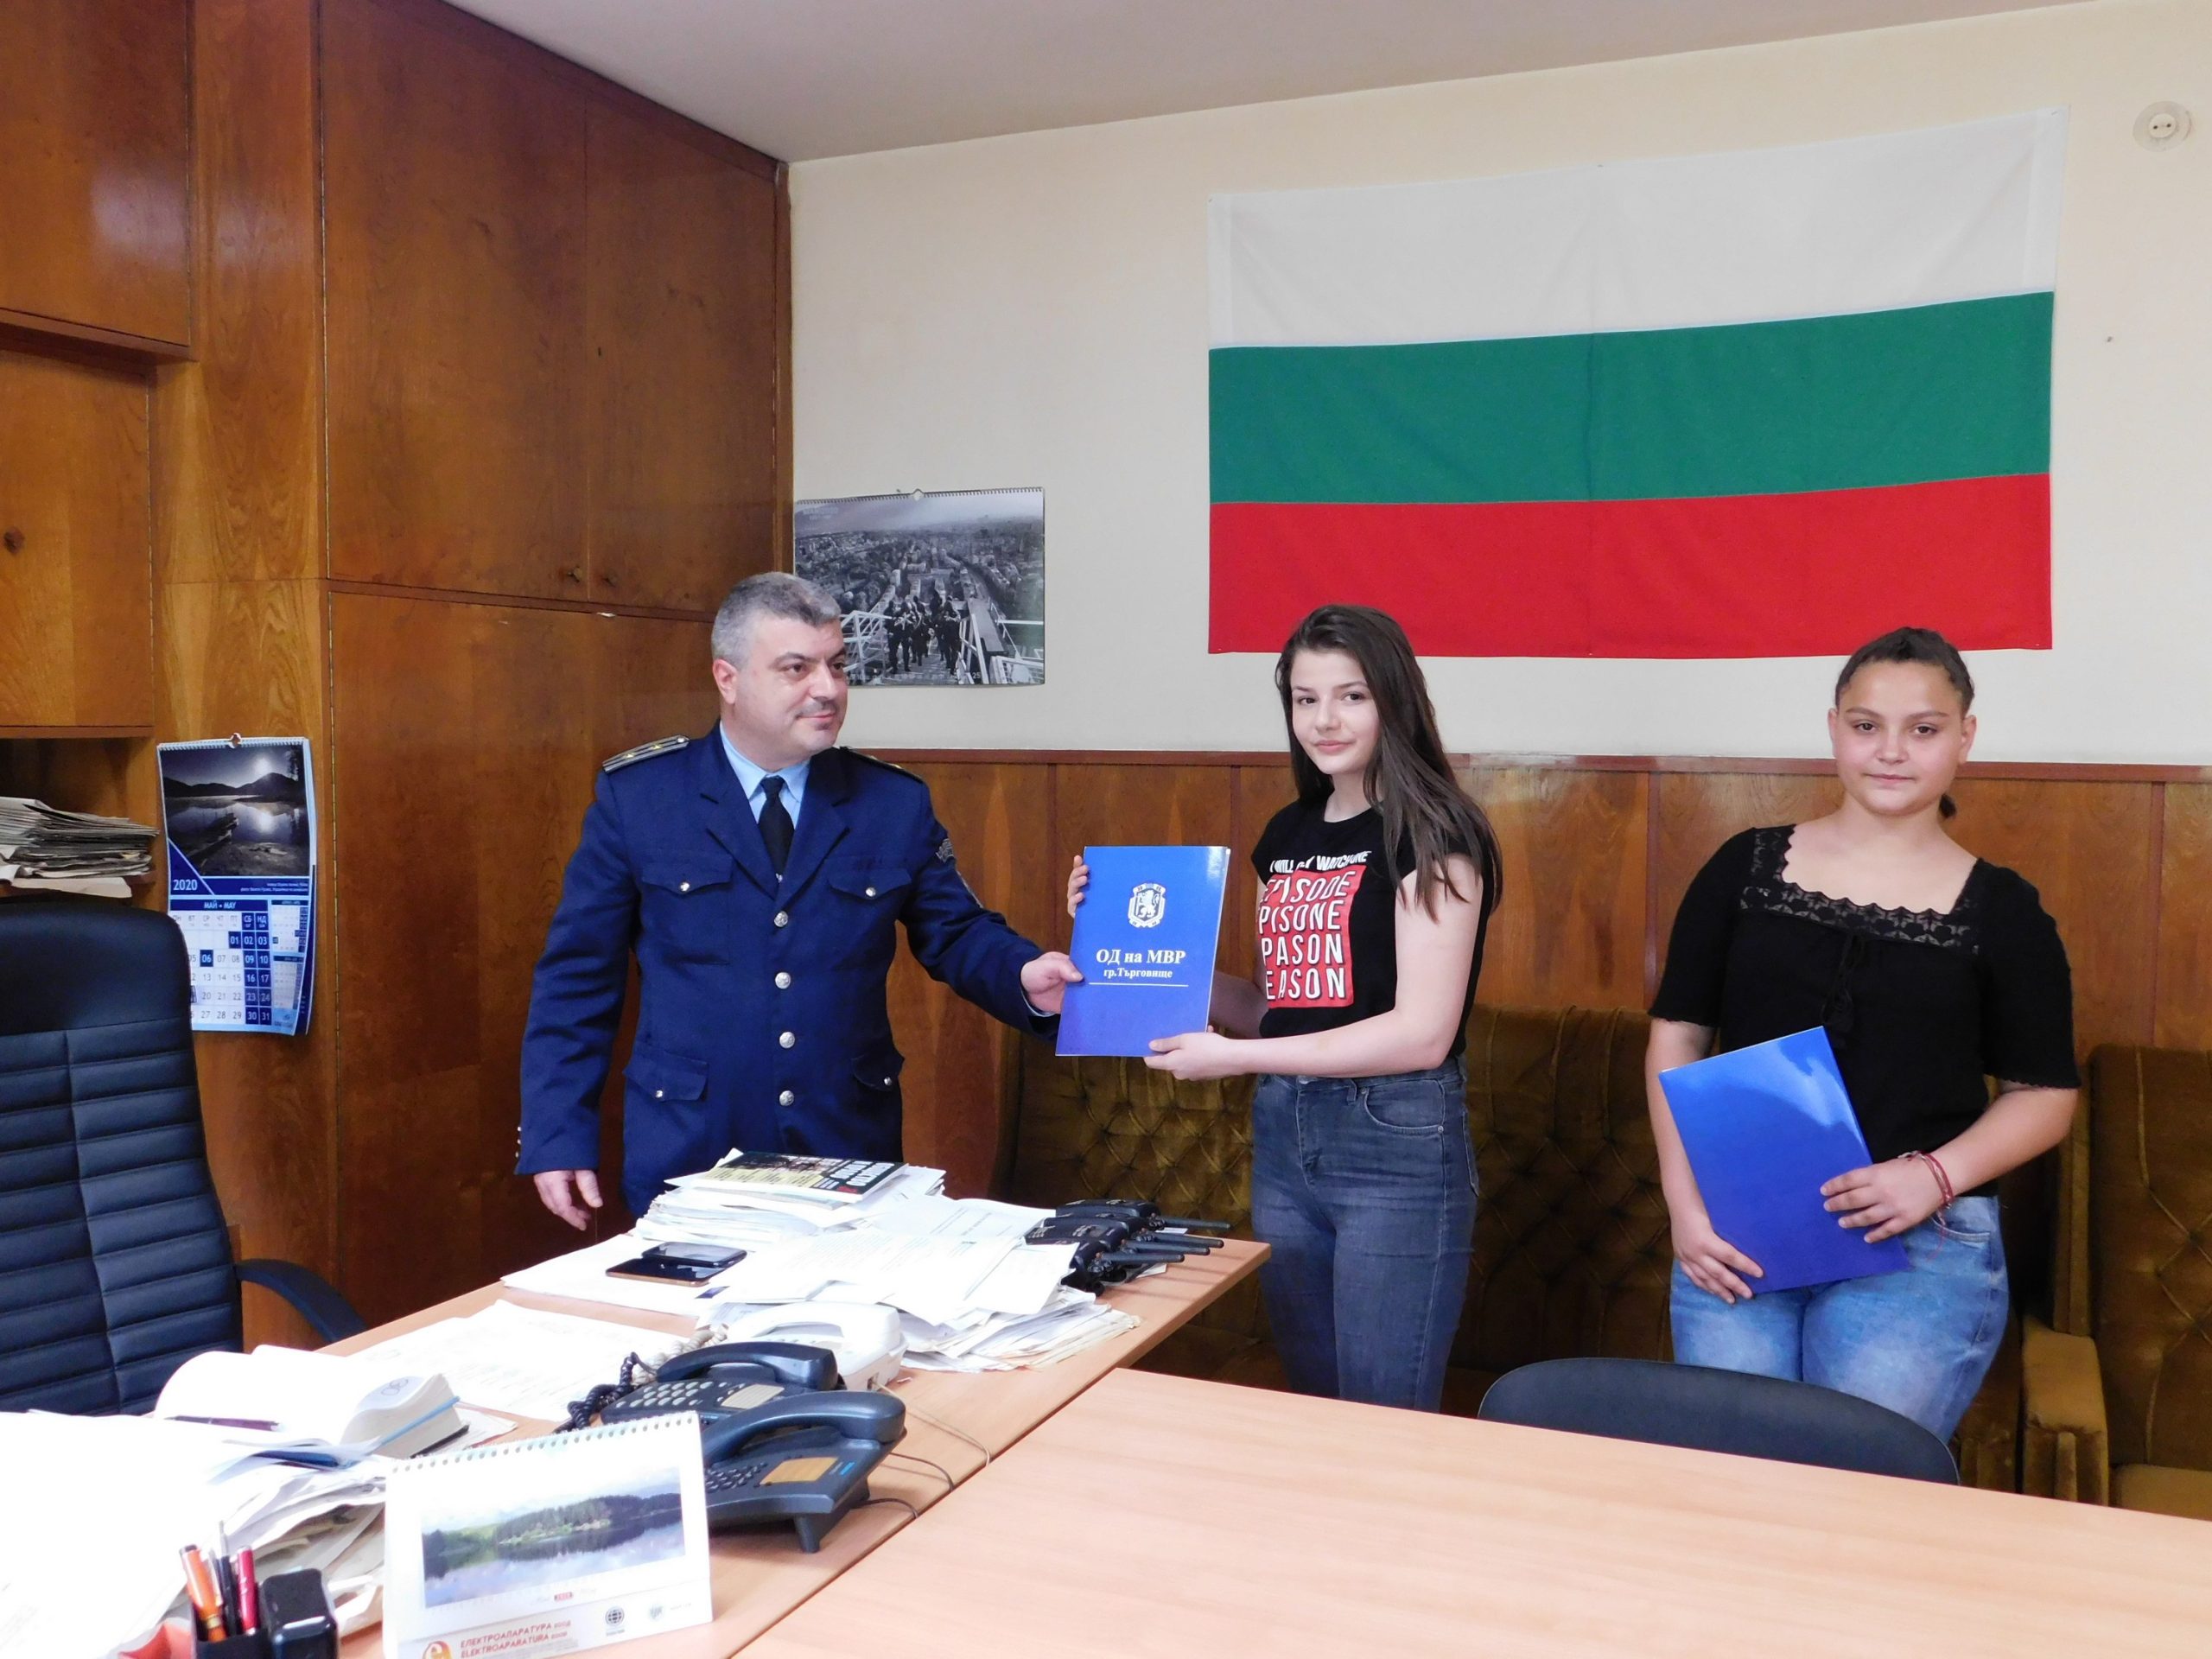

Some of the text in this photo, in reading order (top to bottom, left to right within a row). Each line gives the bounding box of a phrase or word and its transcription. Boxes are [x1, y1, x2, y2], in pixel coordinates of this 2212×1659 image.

[173, 879, 198, 891] 2020
[230, 936, 267, 945] 01 02 03
[201, 954, 212, 963] 06
[217, 954, 226, 963] 07
[231, 955, 240, 963] 08
[245, 955, 255, 963] 09
[259, 956, 269, 964] 10
[1096, 949, 1186, 966] ОД на МВР
[261, 974, 270, 983] 17
[246, 993, 257, 1001] 23
[260, 993, 270, 1001] 24
[247, 1011, 257, 1020] 30
